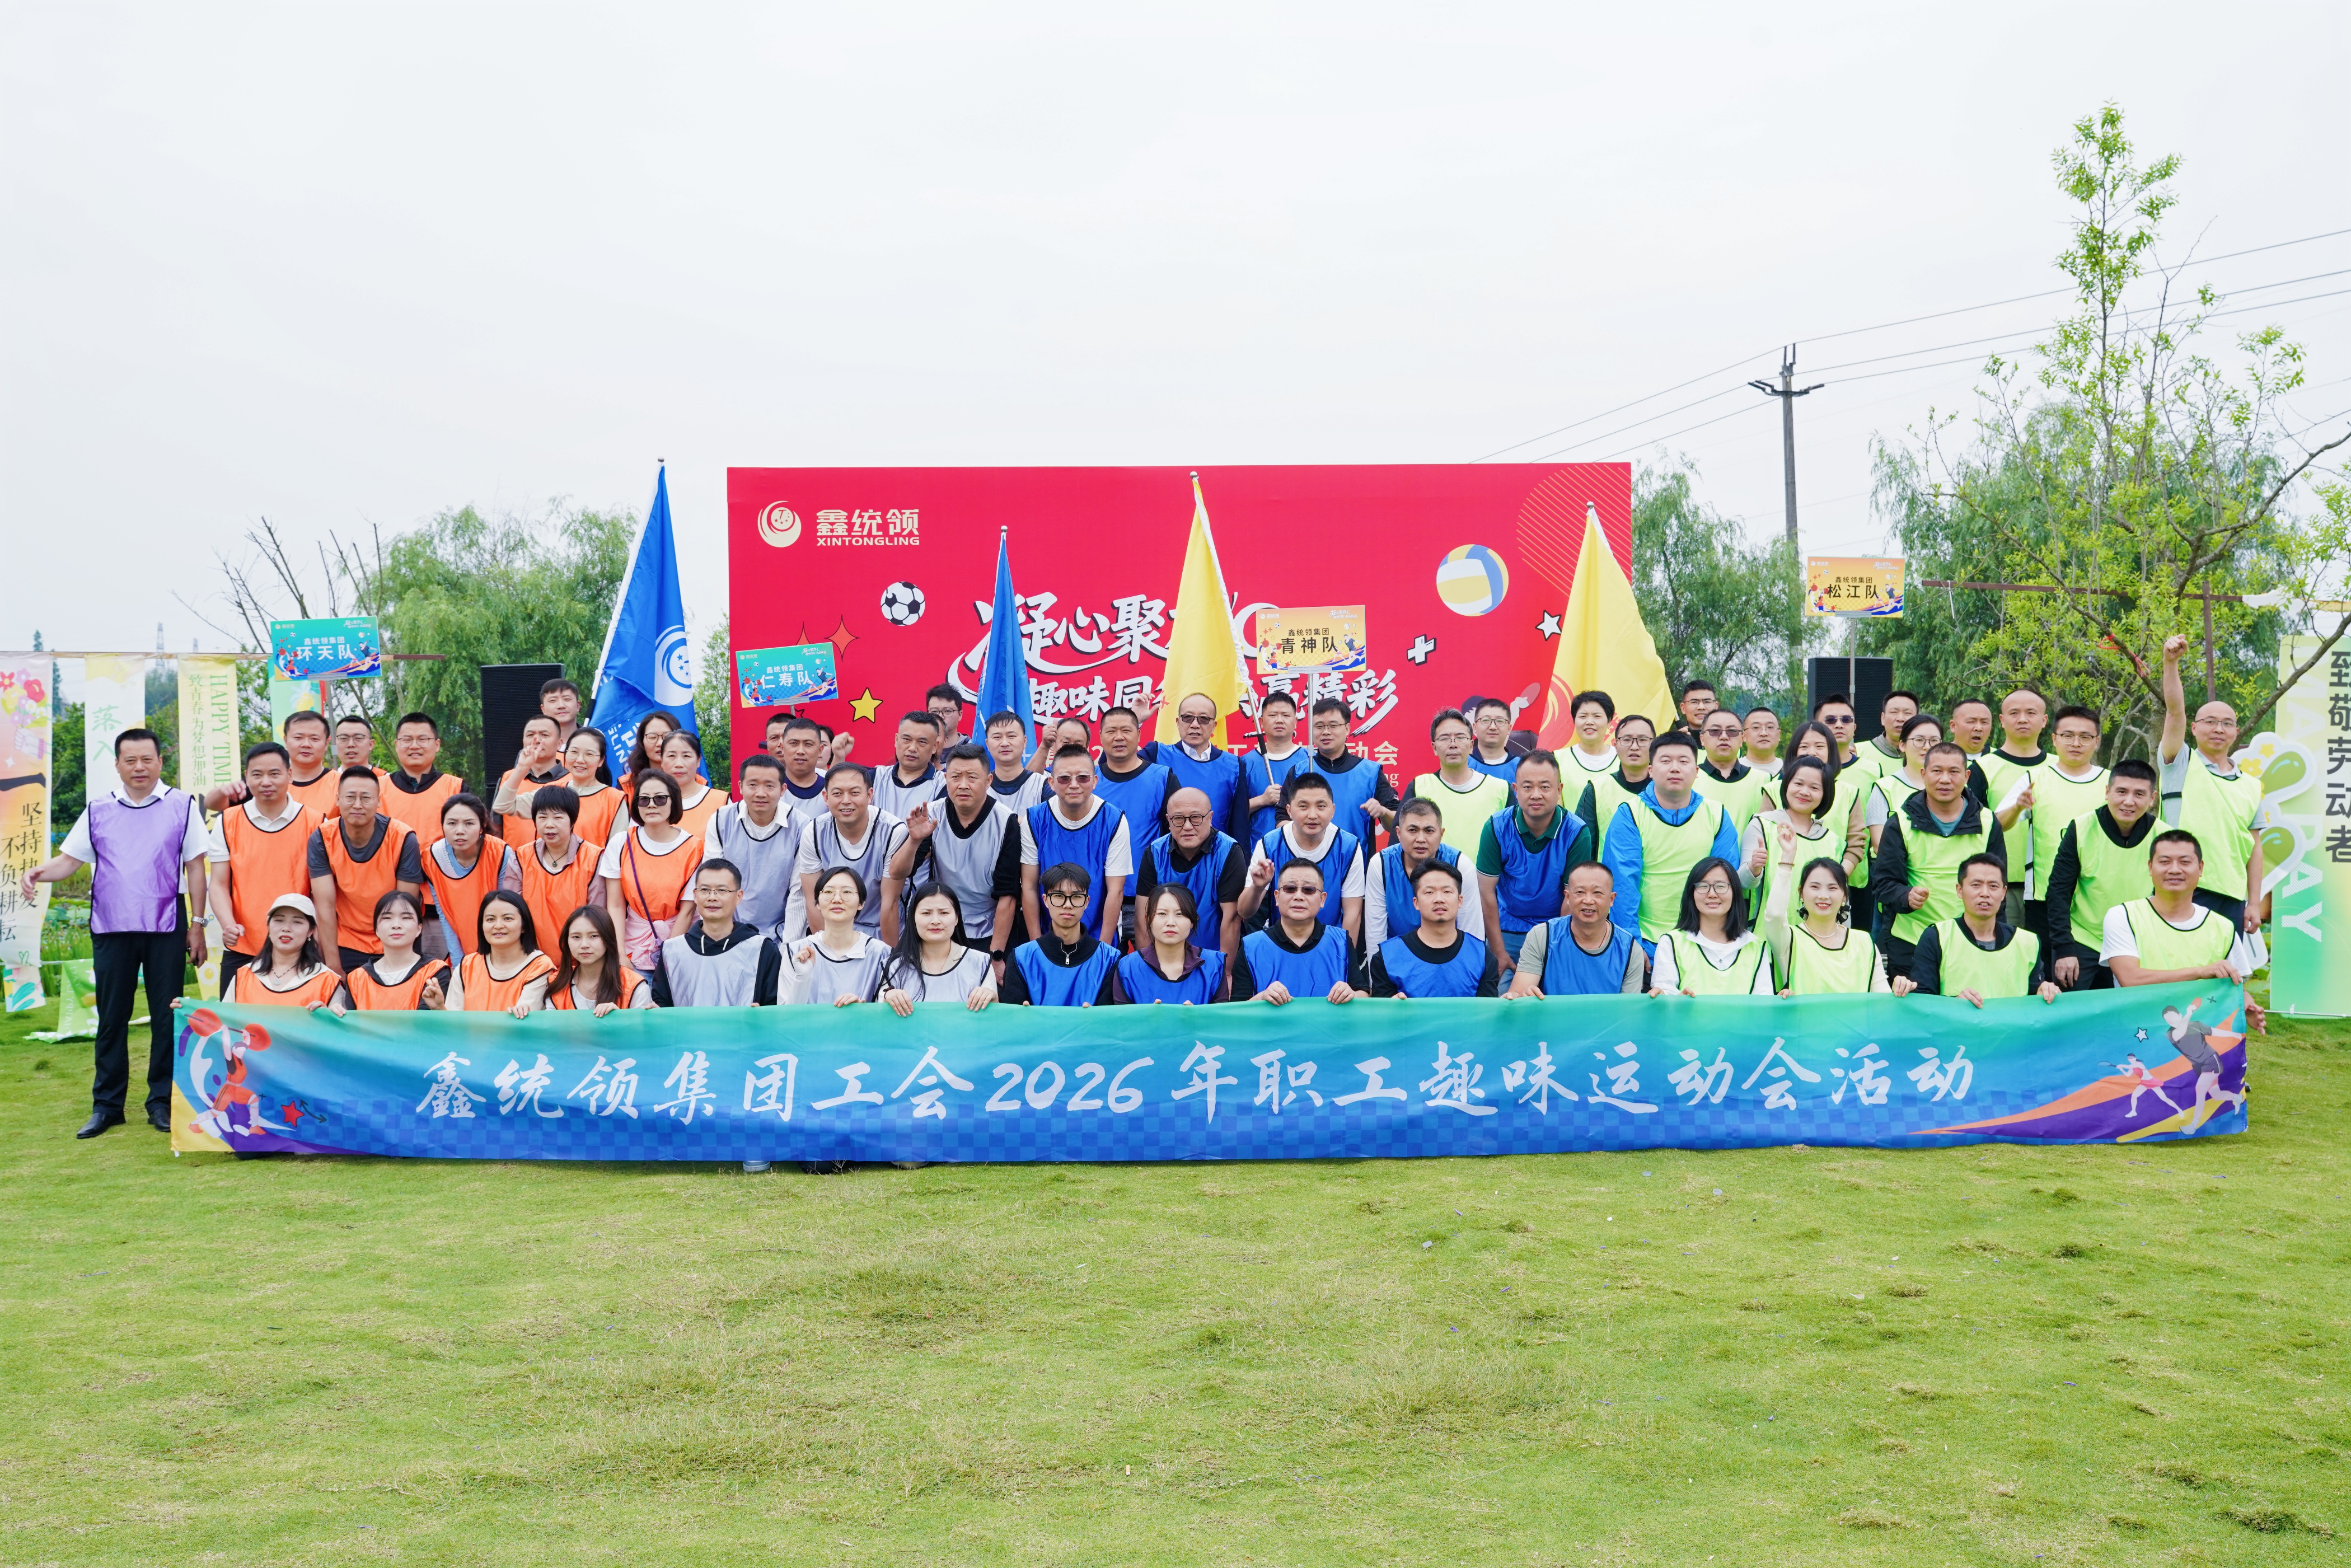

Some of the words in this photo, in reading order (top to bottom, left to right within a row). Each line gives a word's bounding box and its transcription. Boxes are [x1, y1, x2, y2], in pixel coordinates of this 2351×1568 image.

[816, 509, 919, 536] 鑫统领
[816, 537, 920, 546] XINTONGLING
[1827, 584, 1879, 599] 松江队
[304, 636, 345, 645] 鑫统领集团
[965, 591, 1238, 673] 凝心聚
[1288, 628, 1329, 636] 鑫统领集团
[296, 644, 352, 661] 环天队
[1280, 636, 1338, 654] 青神队
[766, 663, 803, 673] 鑫统领集团
[760, 671, 811, 689] 仁寿队
[210, 675, 230, 735] HAPPY
[416, 1037, 1974, 1125] 鑫统领集团工会2026年职工趣味运动会活动
